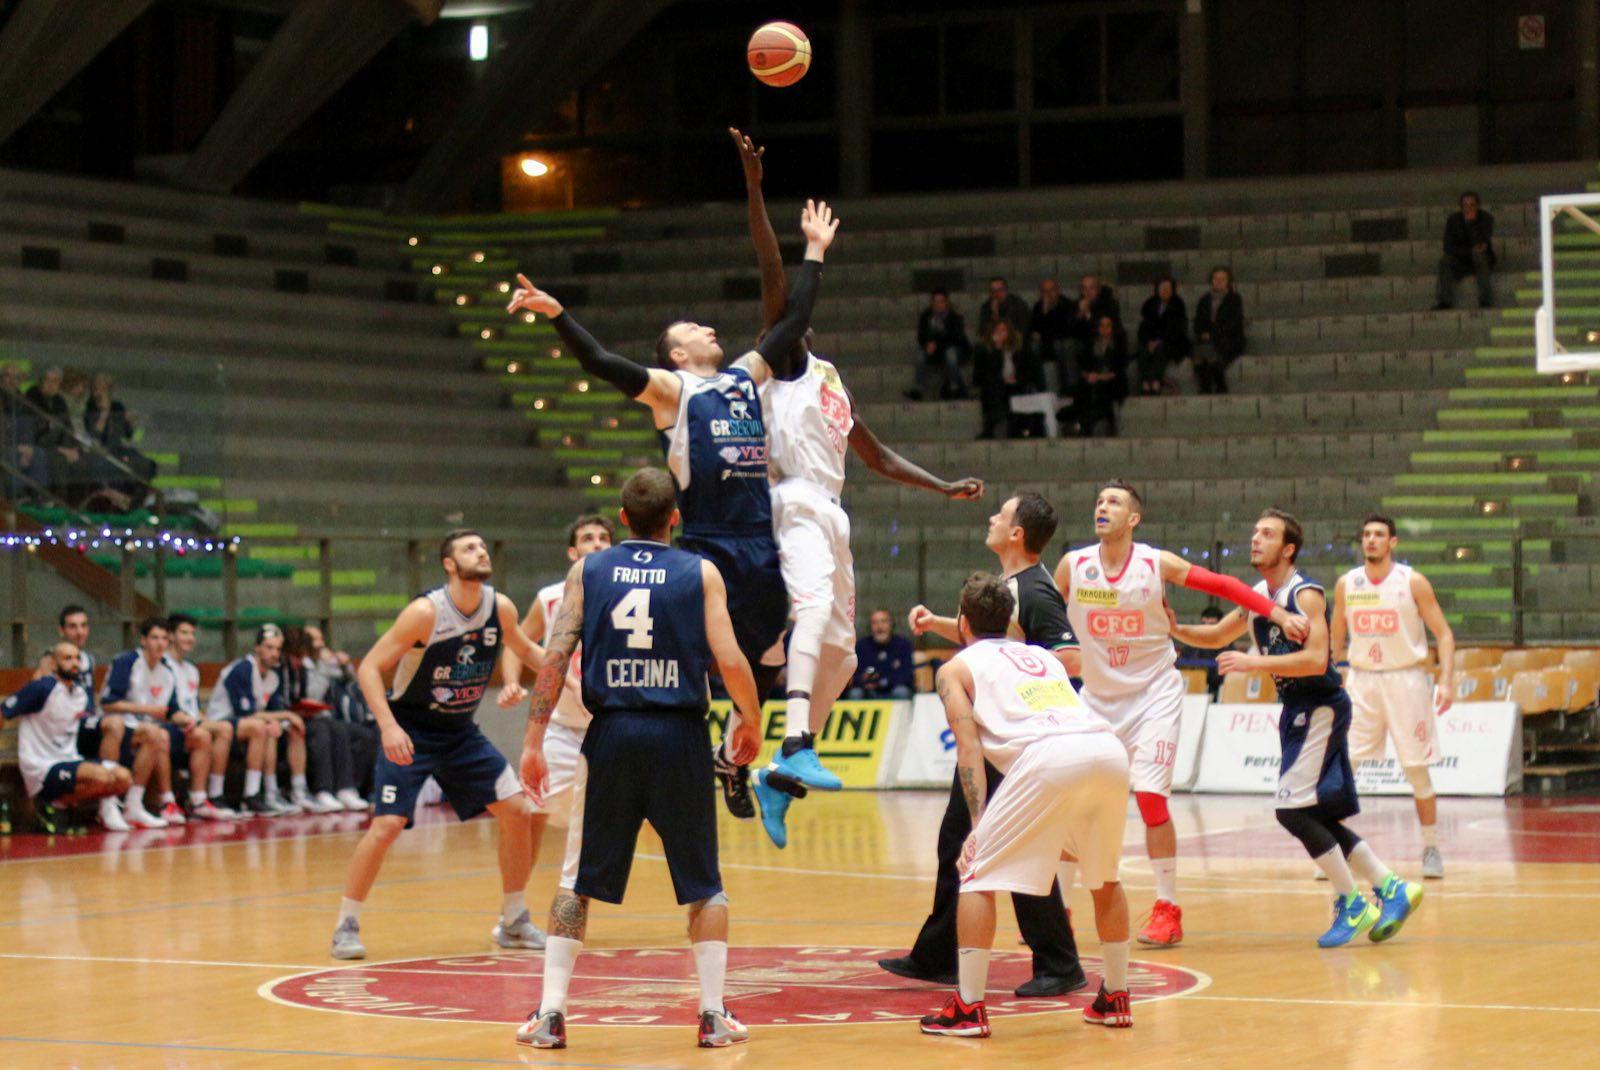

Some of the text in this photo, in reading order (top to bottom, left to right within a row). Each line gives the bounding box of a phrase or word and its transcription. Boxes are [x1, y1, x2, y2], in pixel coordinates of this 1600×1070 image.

[612, 566, 666, 584] FRATTO
[611, 588, 654, 650] 4
[1092, 615, 1139, 632] CFG
[1357, 613, 1395, 631] CFG
[483, 627, 498, 647] 5
[1107, 645, 1130, 668] 17
[606, 659, 679, 689] CECINA
[1154, 740, 1176, 768] 17
[382, 785, 397, 804] 5
